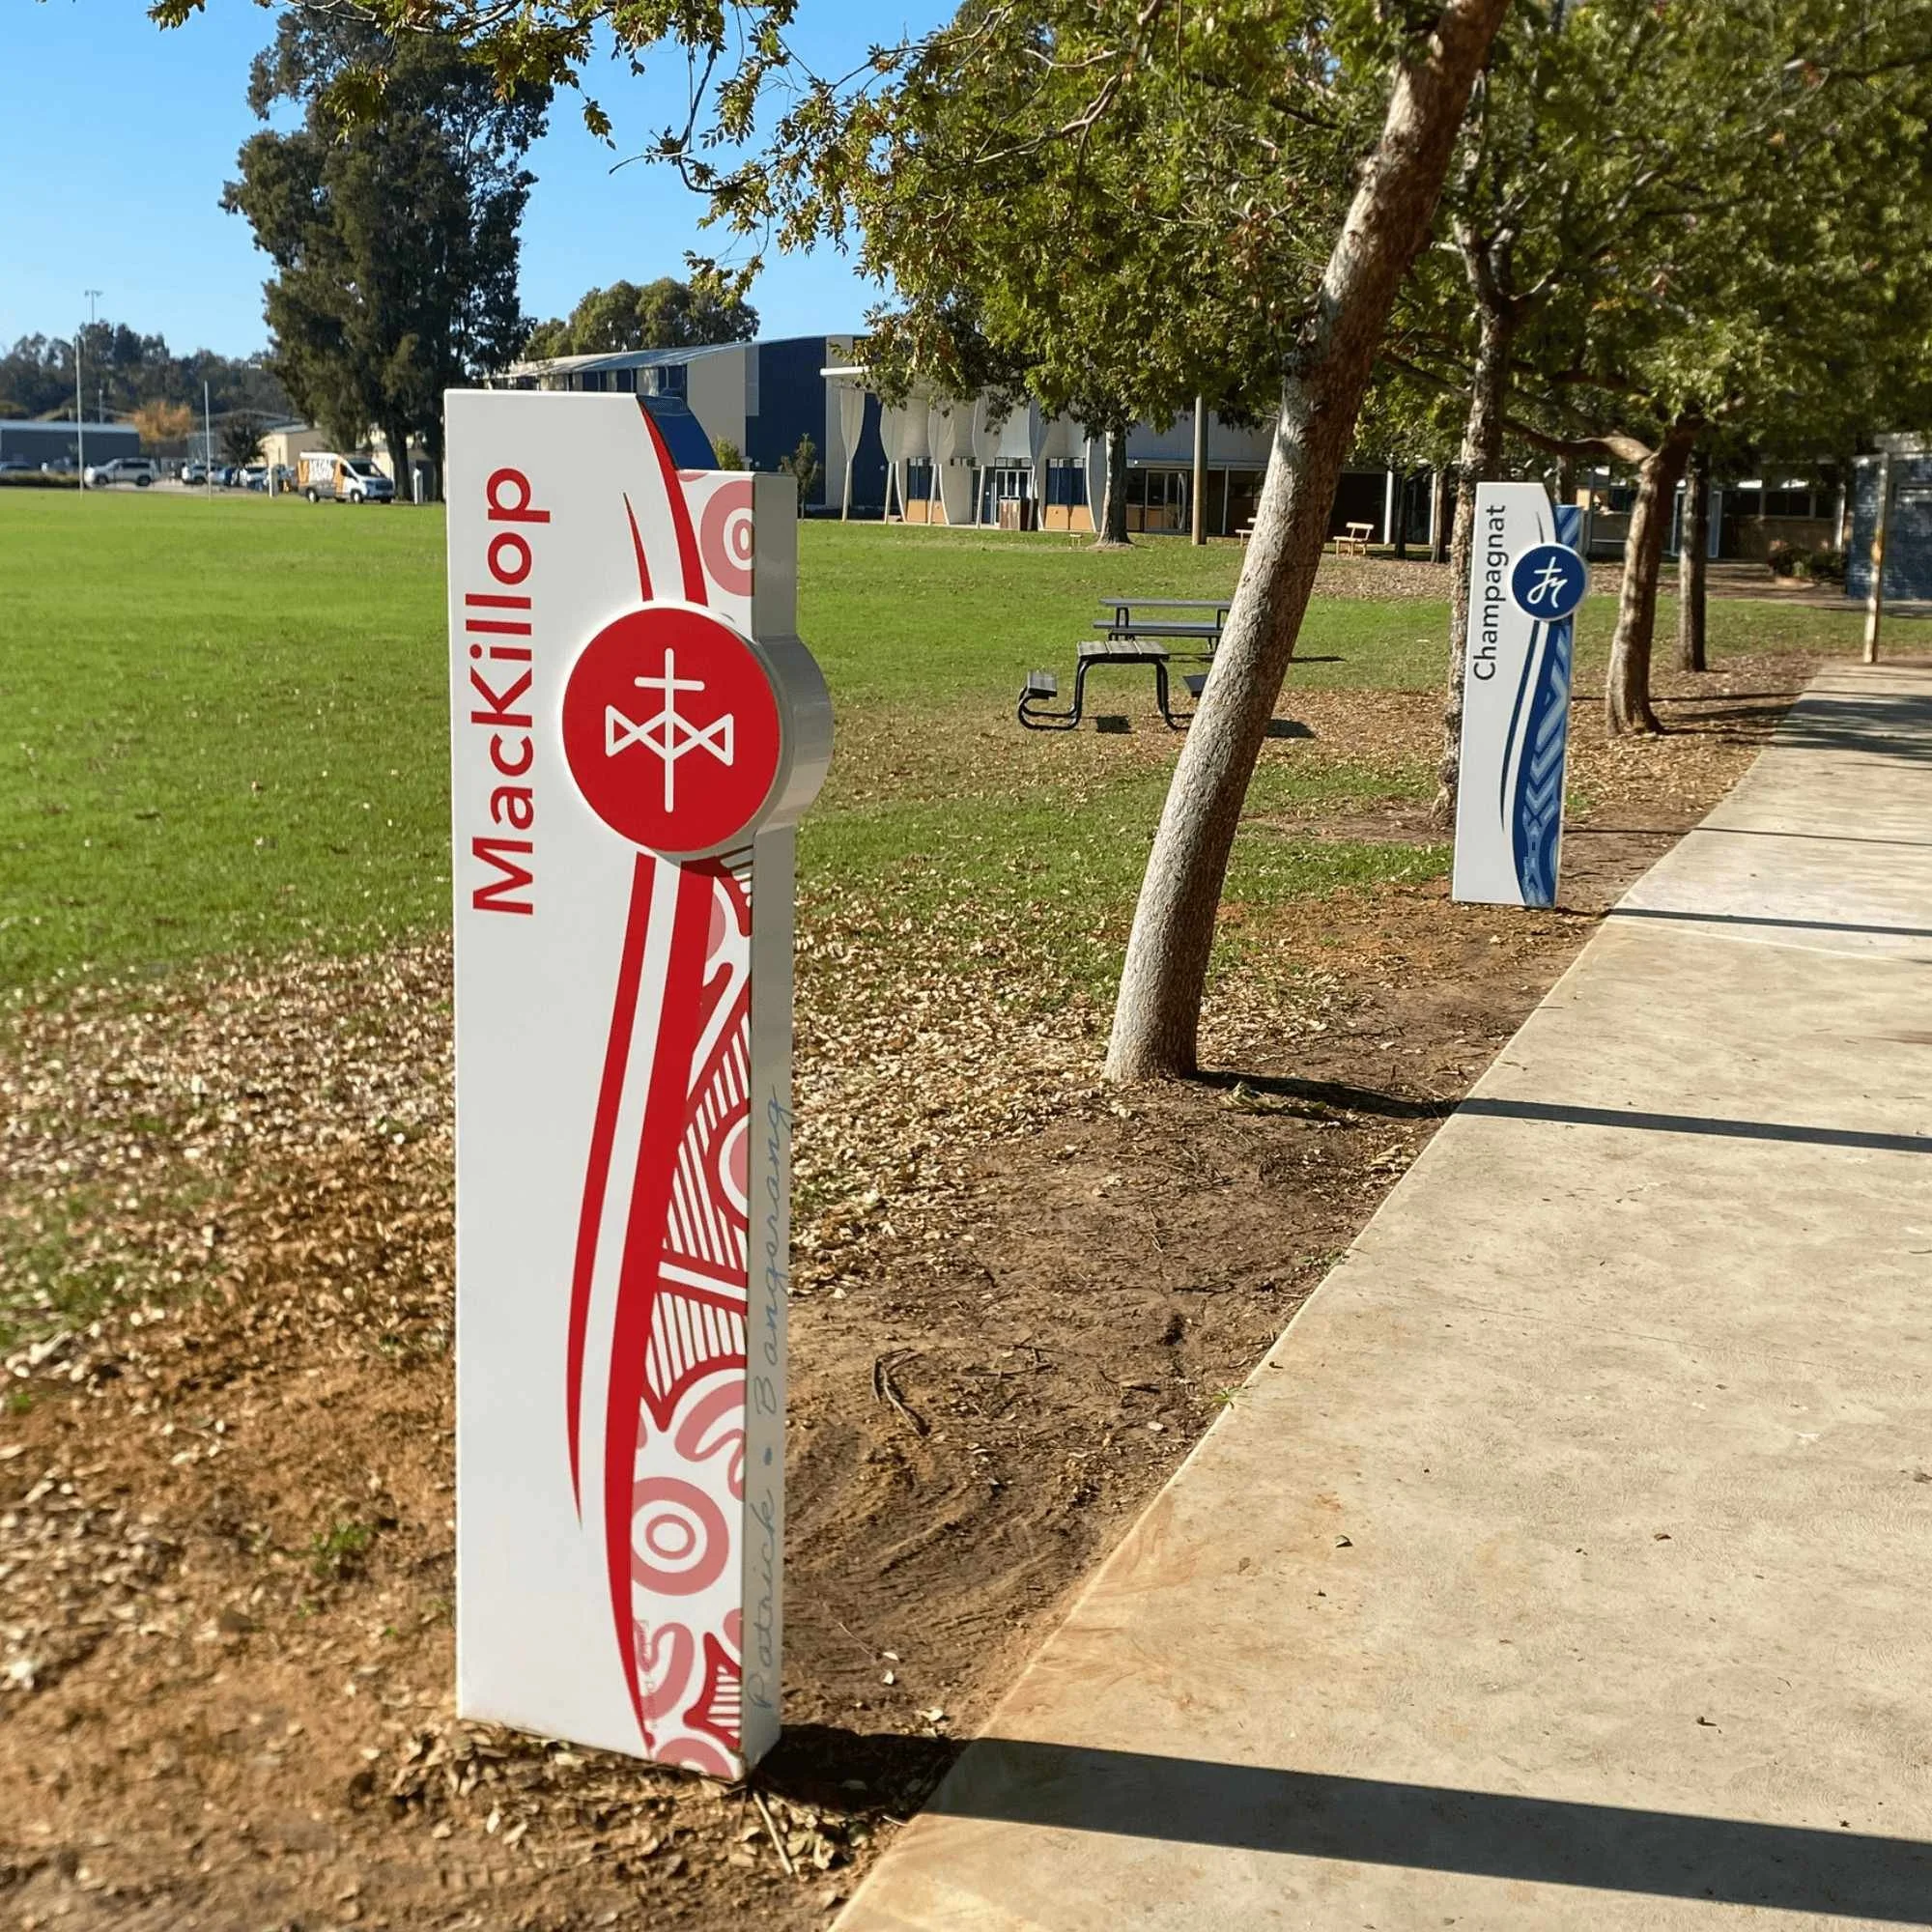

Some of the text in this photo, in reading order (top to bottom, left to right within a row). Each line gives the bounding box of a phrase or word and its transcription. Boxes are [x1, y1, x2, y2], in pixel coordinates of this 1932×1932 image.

[465, 468, 551, 916] MacKillop
[1473, 504, 1509, 680] Champagnat
[748, 1489, 775, 1709] Patrick
